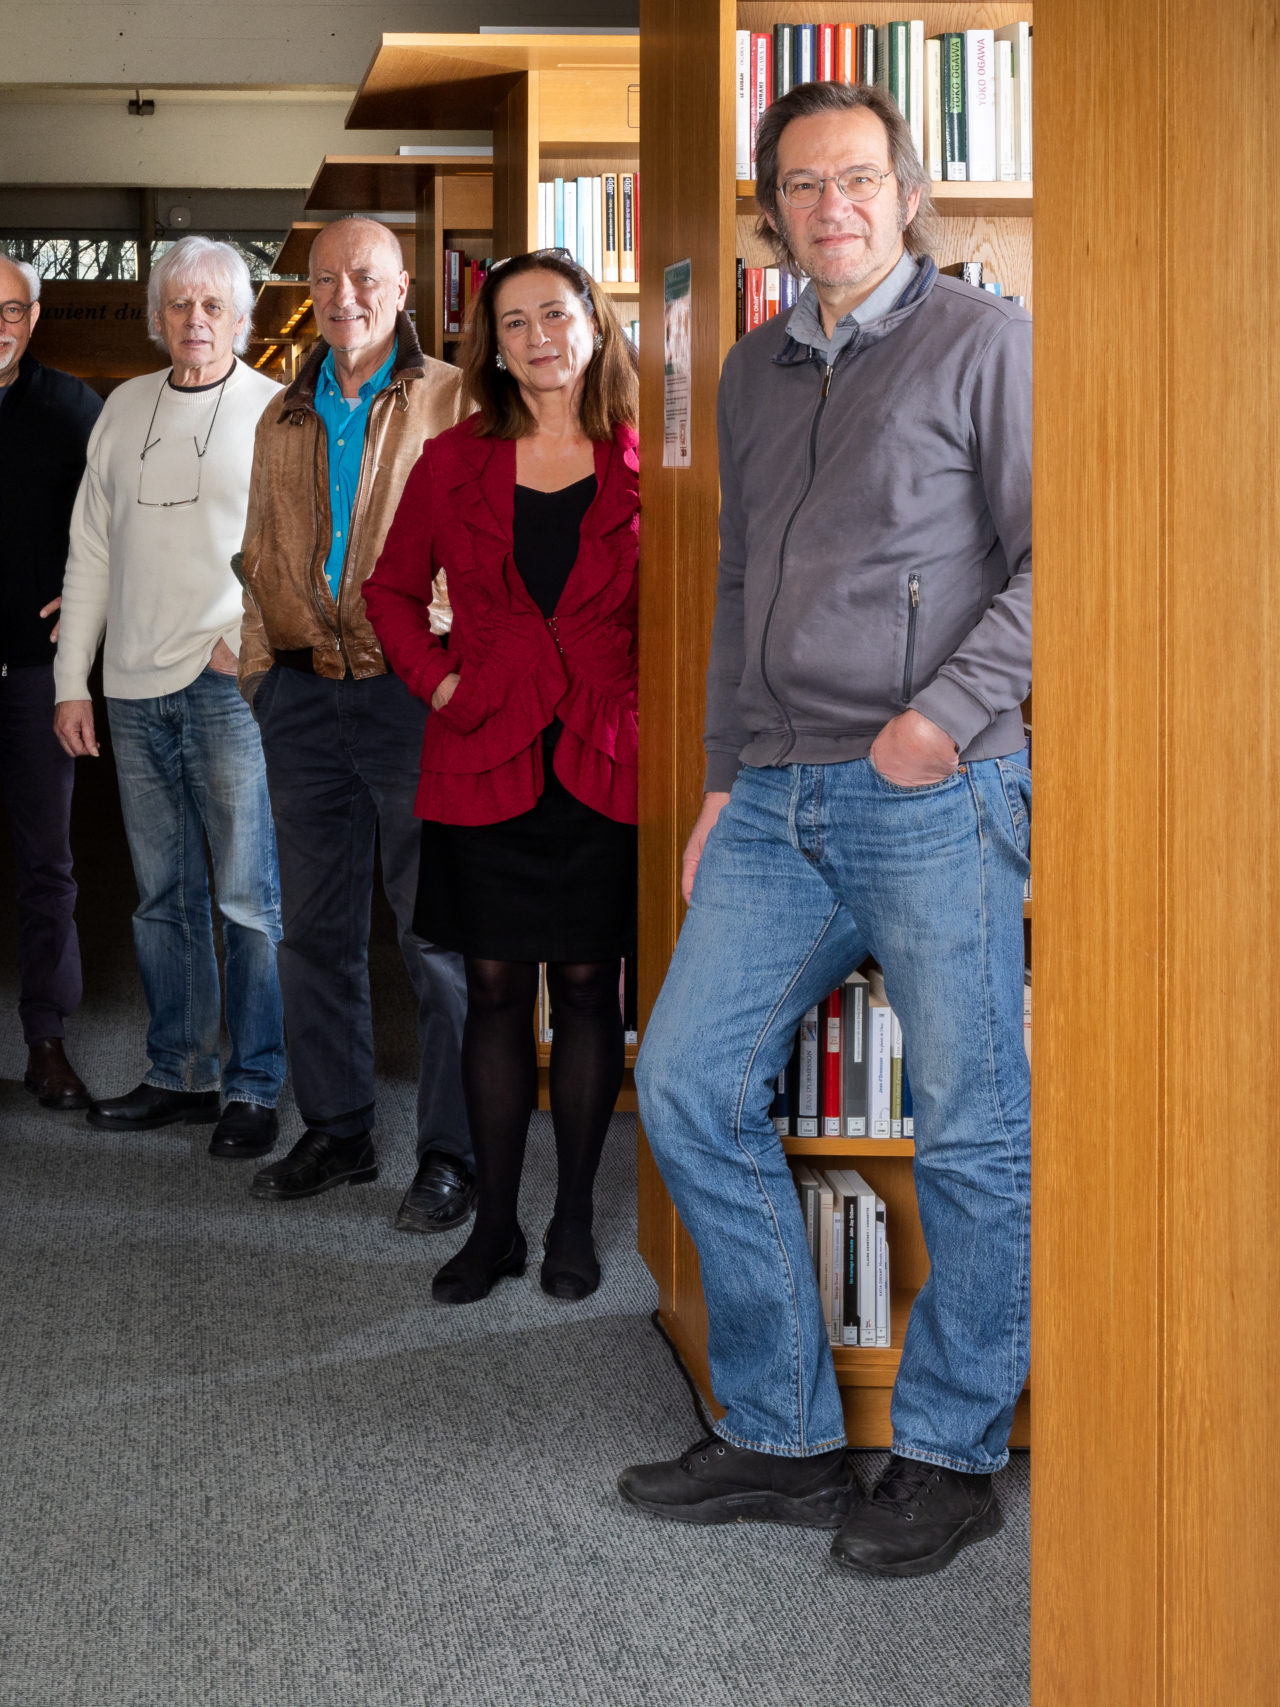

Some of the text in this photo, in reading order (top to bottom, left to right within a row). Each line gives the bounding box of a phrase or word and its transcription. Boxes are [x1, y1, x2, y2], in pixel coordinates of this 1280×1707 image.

[951, 41, 960, 78] OGAWA
[977, 38, 986, 76] OGAWA
[40, 302, 142, 320] uvient du
